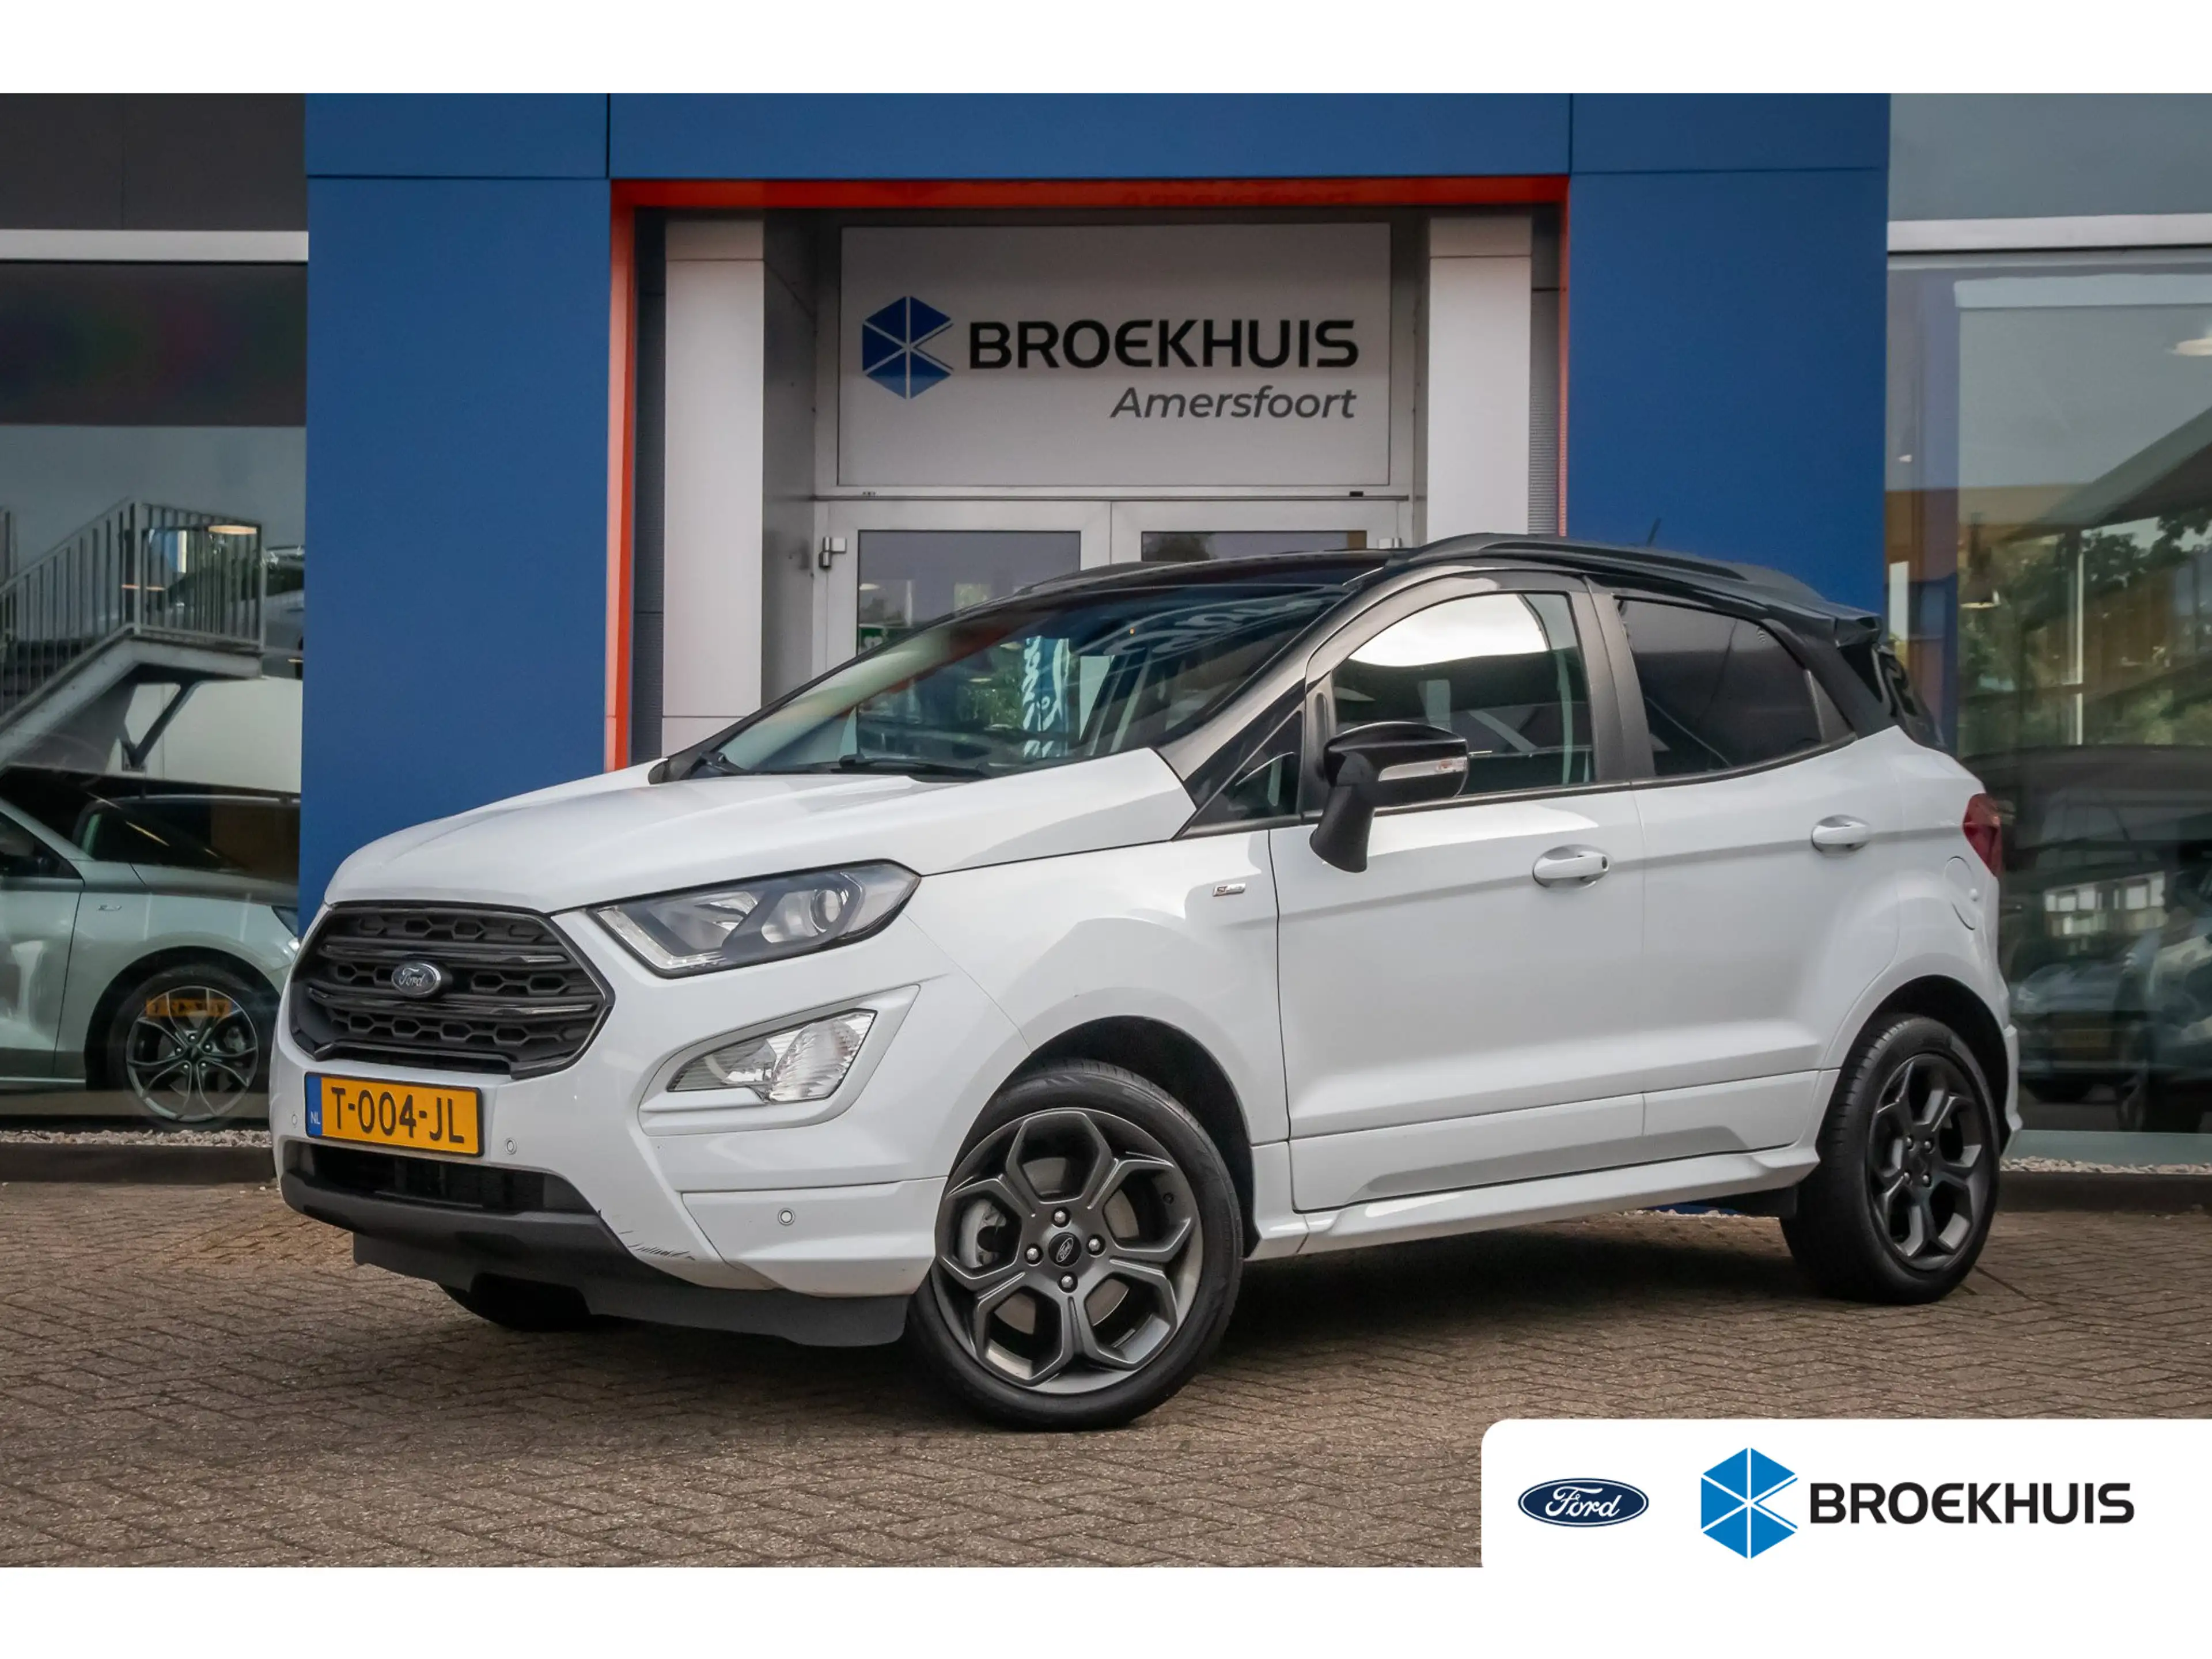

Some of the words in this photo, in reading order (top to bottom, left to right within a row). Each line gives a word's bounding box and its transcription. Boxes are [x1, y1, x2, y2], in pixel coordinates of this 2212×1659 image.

[969, 319, 1359, 369] BROEKHUIS
[1109, 384, 1358, 419] Amersfoort
[398, 967, 426, 987] Ford
[310, 1111, 321, 1125] NL
[331, 1086, 465, 1144] T-004-JL
